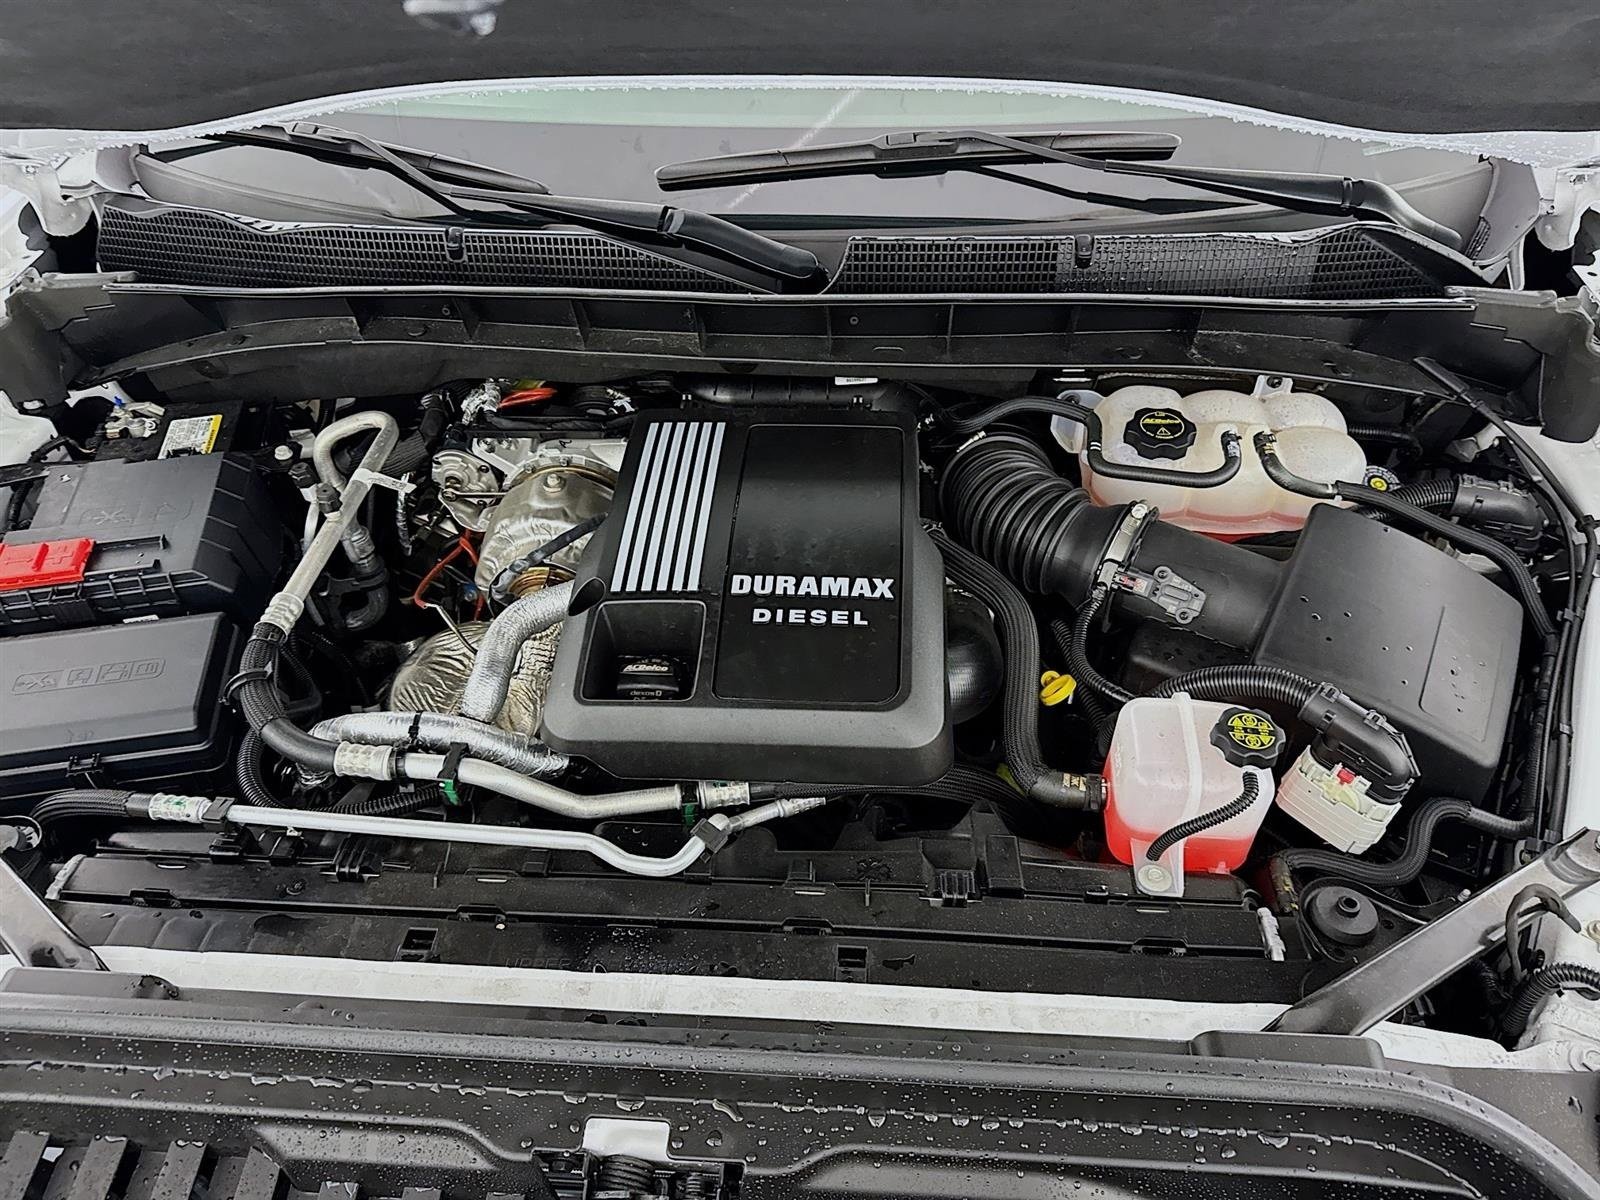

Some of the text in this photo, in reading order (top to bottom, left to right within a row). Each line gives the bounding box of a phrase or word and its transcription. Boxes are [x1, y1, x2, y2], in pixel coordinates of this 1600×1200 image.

[730, 574, 895, 599] DURAMAX
[752, 608, 869, 627] DIESEL
[622, 664, 669, 672] ACDelco
